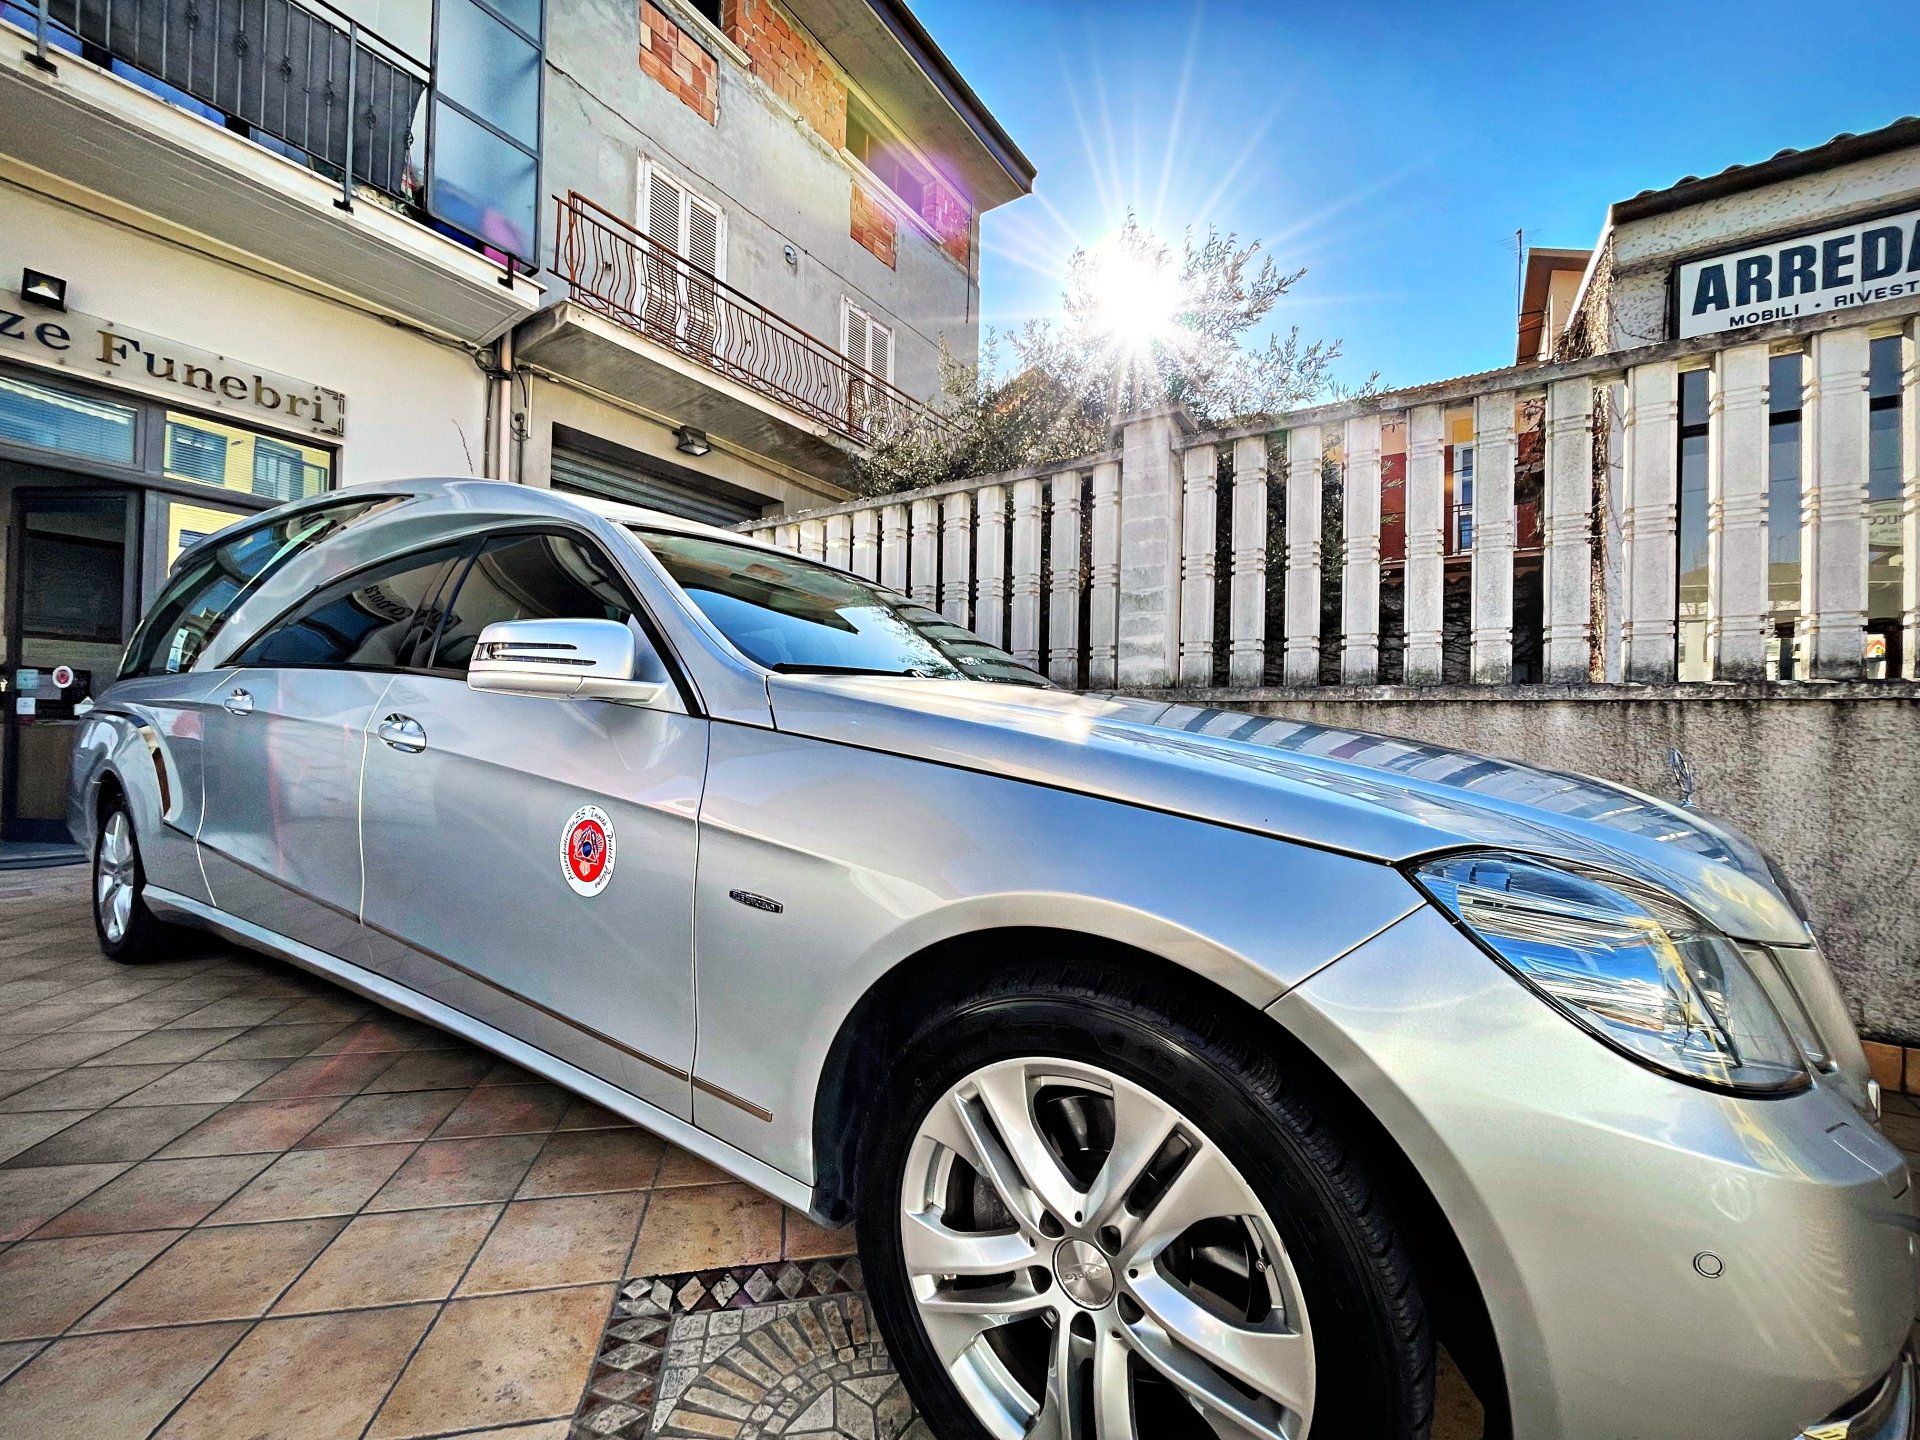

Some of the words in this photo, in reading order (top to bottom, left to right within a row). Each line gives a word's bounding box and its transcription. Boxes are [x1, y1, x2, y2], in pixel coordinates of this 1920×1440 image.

[1729, 303, 1799, 328] MOBILI
[1834, 280, 1920, 308] RIVEST
[0, 310, 71, 351] ze
[96, 330, 324, 424] Funebri
